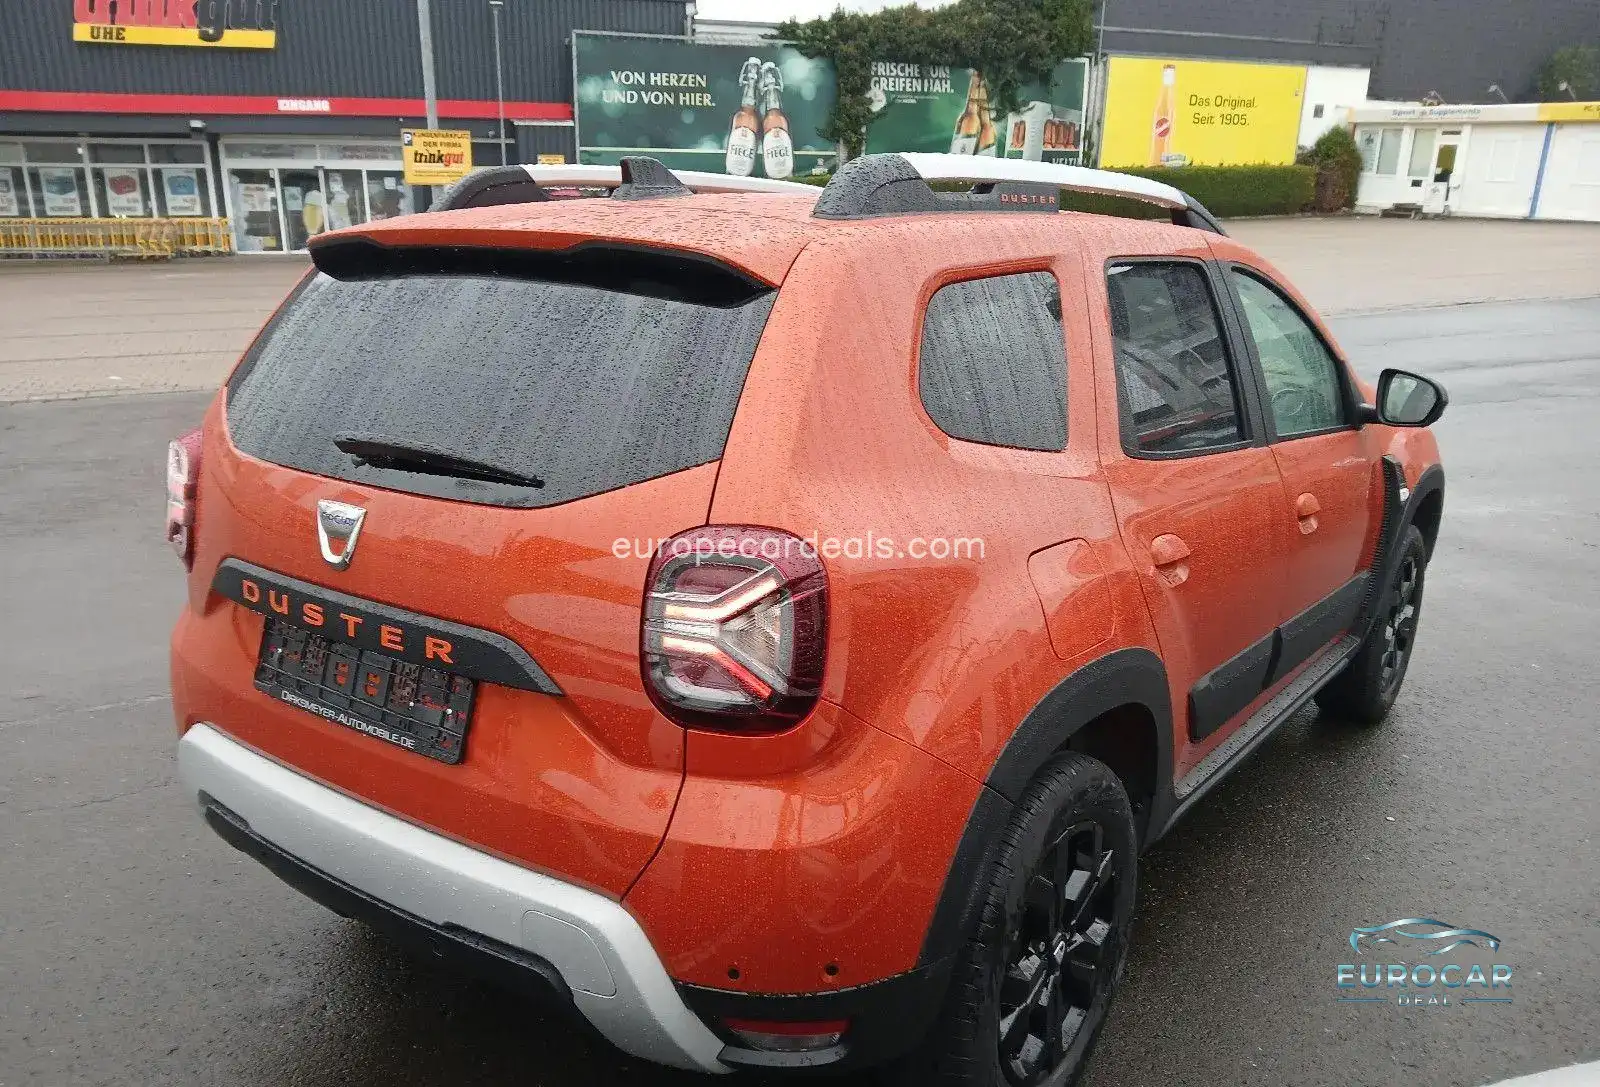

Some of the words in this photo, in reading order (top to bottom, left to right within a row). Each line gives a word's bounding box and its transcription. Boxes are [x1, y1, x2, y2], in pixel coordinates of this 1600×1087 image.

[89, 25, 126, 41] UHE
[870, 61, 920, 77] FRISCHE
[611, 70, 646, 85] VON
[649, 72, 707, 88] HERZEN
[870, 76, 922, 92] GREIFEN
[602, 90, 638, 104] UND
[640, 90, 675, 105] VON
[679, 92, 716, 106] HIER.
[1189, 94, 1210, 106] Das
[1192, 112, 1215, 125] Seit
[1219, 113, 1250, 126] 1905.
[413, 149, 464, 167] trinkgut
[1001, 193, 1057, 205] DUSTER
[242, 579, 454, 664] DUSTER
[280, 690, 417, 750] DIRKSMEYER-AUTOMOBILE.DE
